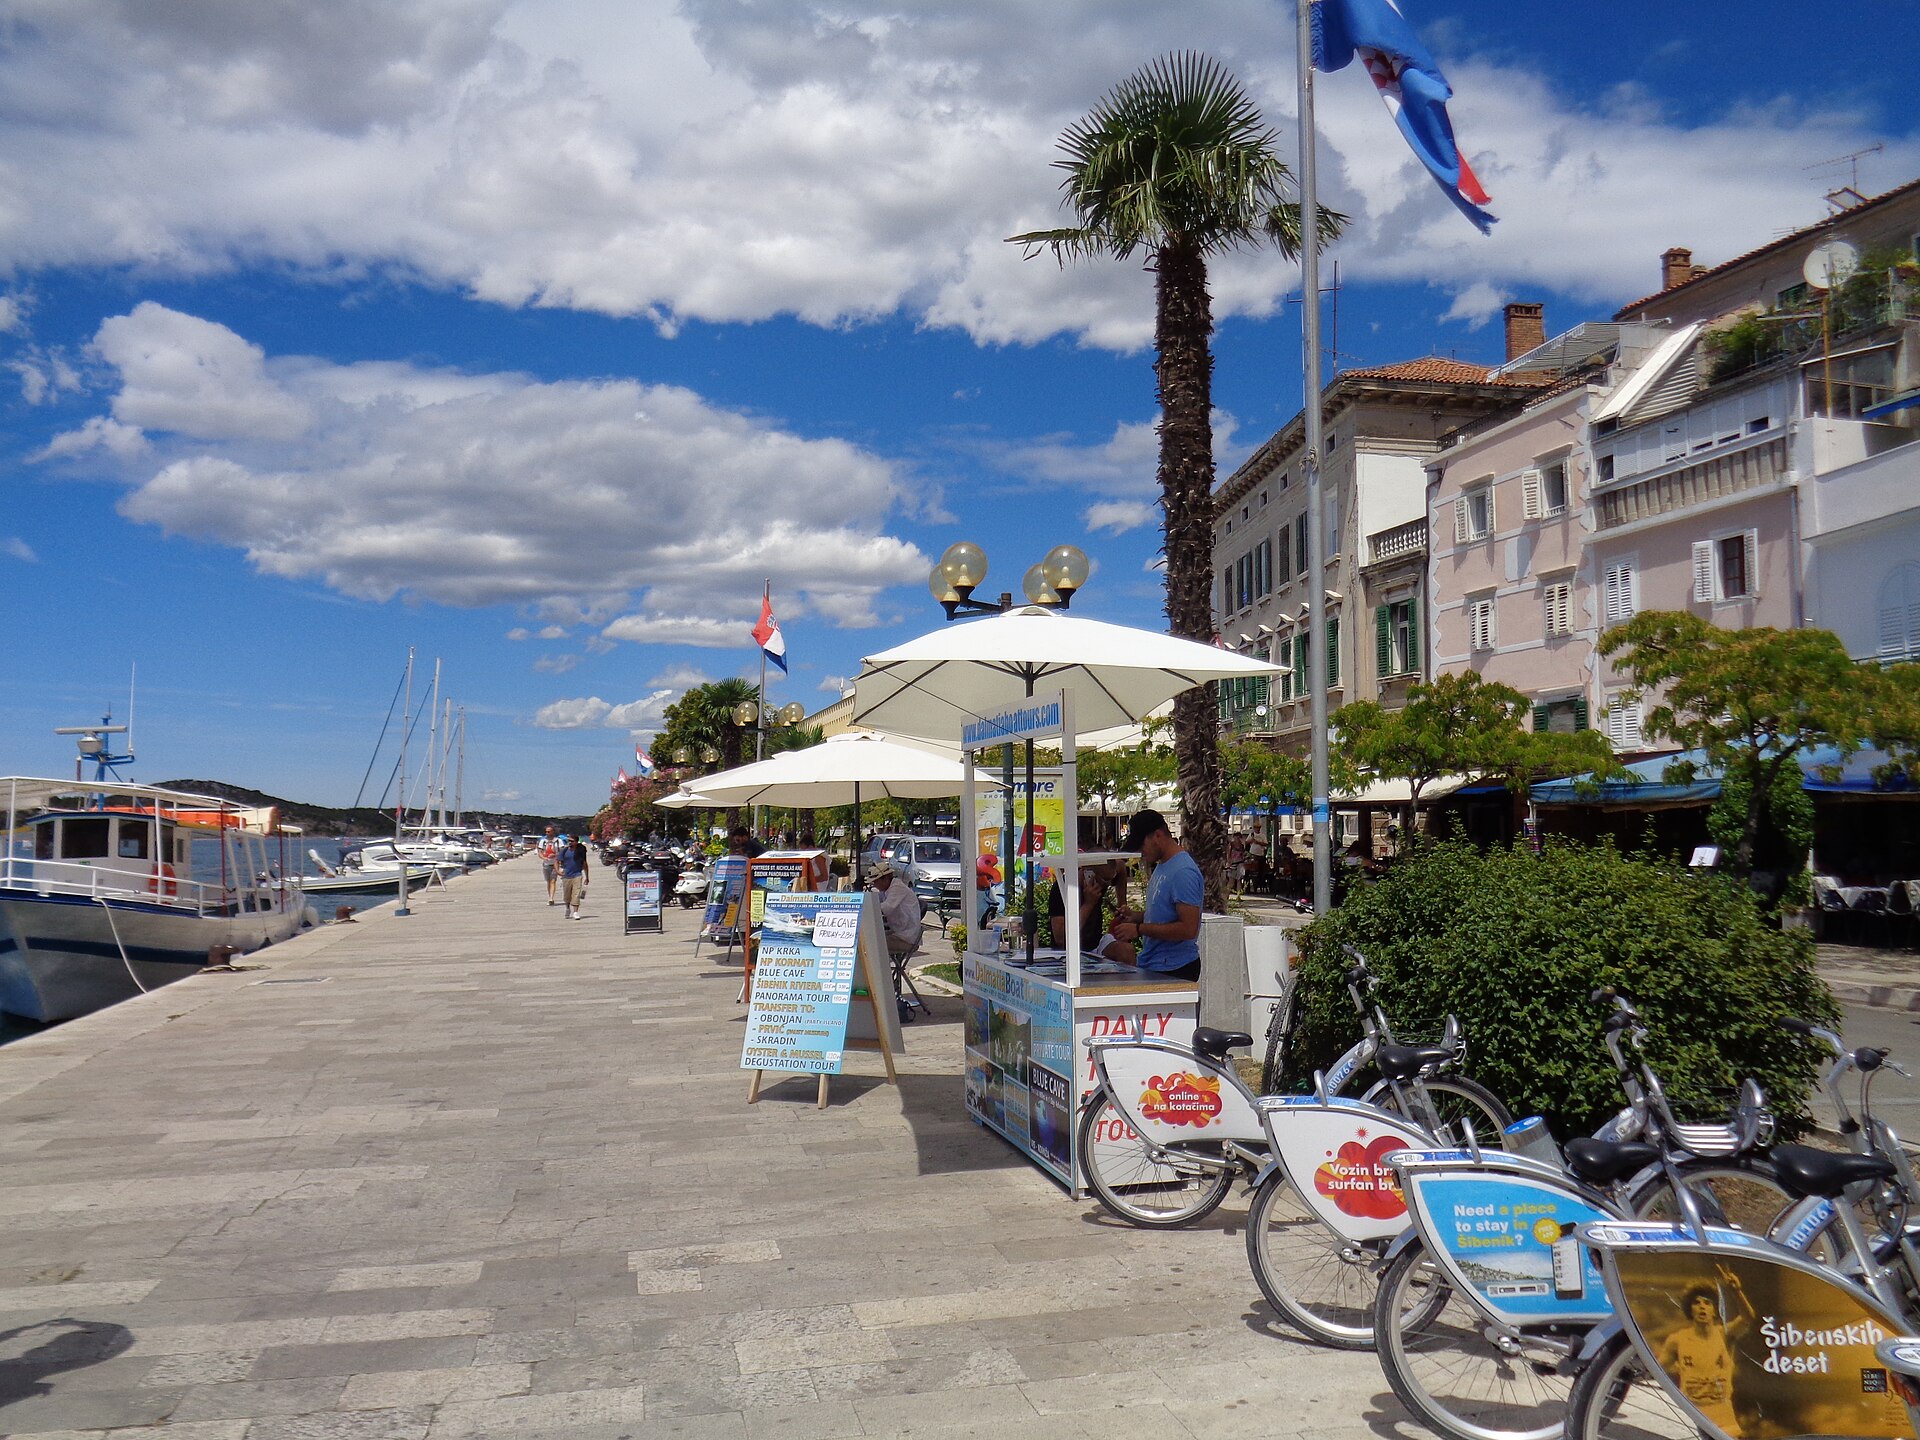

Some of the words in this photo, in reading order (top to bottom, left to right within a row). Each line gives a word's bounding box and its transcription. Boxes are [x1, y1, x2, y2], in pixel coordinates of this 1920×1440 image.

[761, 946, 774, 955] NP
[776, 947, 800, 956] KRKA
[760, 957, 773, 967] NP
[775, 957, 815, 968] KORNATI
[758, 968, 780, 977] BLUE
[783, 969, 805, 978] CAVE
[756, 977, 788, 989] ŠIBENIK
[789, 981, 823, 991] RIVIERA
[754, 991, 803, 1002] PANORAMA
[806, 993, 830, 1003] TOUR
[753, 1002, 798, 1012] TRANSFER
[800, 1004, 815, 1013] TO:
[760, 1014, 802, 1025] OBONJAN
[1091, 1013, 1173, 1037] DALY
[758, 1024, 785, 1034] PRVIĆ
[756, 1035, 797, 1045] SKRADIN
[746, 1047, 778, 1057] OYSTER
[789, 1049, 825, 1060] MUSSEL
[744, 1057, 806, 1069] DEGUSTATION
[810, 1061, 835, 1070] TOUR
[1032, 1068, 1048, 1090] BLUE
[1049, 1077, 1065, 1100] CAVE
[1168, 1091, 1199, 1101] online
[1153, 1103, 1167, 1111] na
[1169, 1101, 1215, 1111] kotačima
[1329, 1163, 1369, 1176] Vozin
[1328, 1177, 1374, 1191] surfan
[1454, 1204, 1494, 1217] Need
[1499, 1206, 1509, 1215] a
[1513, 1202, 1557, 1217] place
[1455, 1220, 1471, 1232] to
[1476, 1220, 1508, 1234] stay
[1513, 1219, 1528, 1230] in
[1458, 1233, 1523, 1248] Šibenik?
[1760, 1316, 1883, 1348] Šibenskih
[1763, 1349, 1828, 1374] deset
